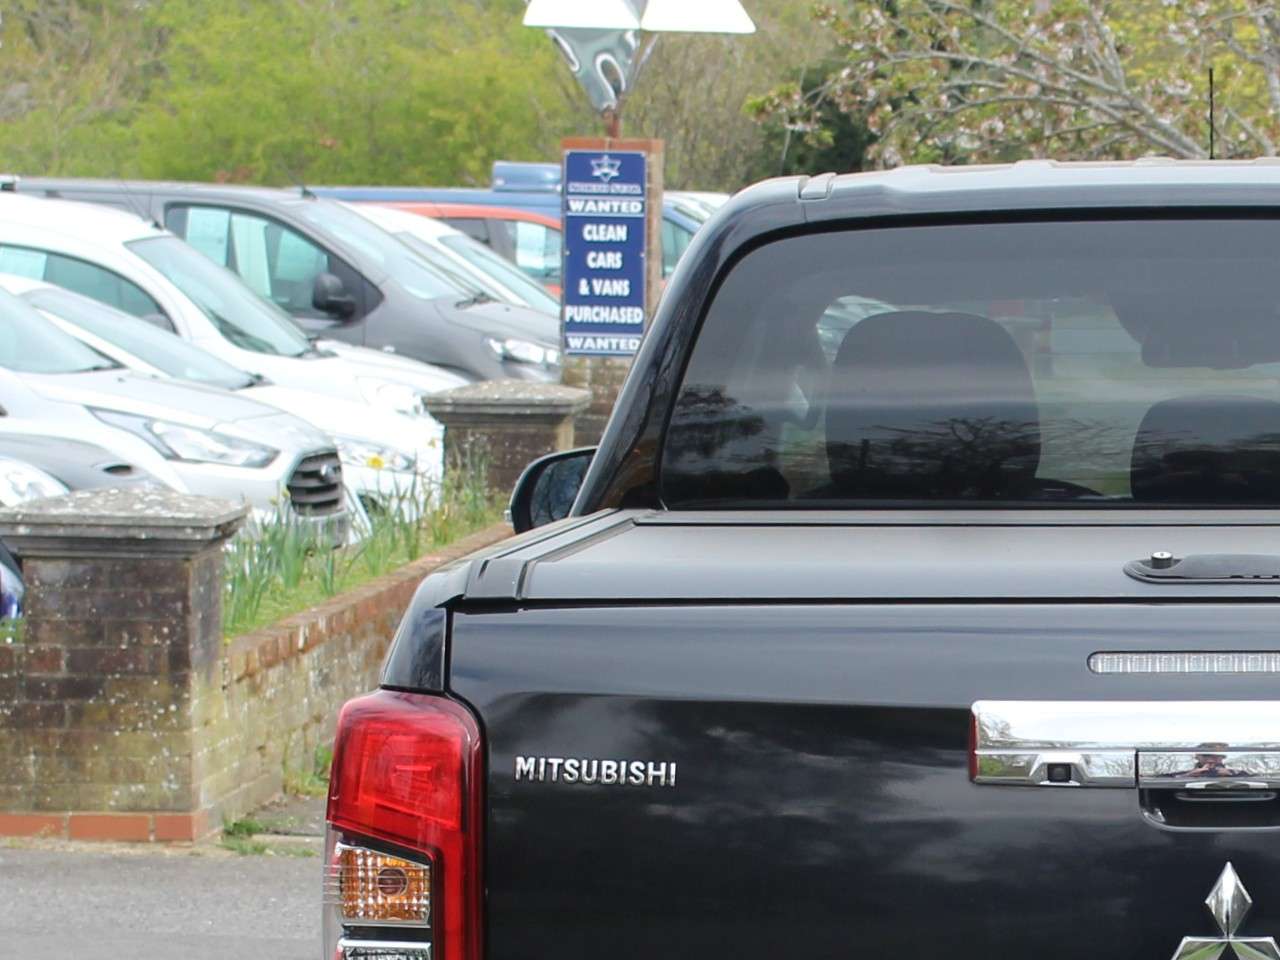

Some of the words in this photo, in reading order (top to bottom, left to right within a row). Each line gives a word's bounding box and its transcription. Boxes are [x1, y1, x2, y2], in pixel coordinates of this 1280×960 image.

[568, 200, 643, 214] WANTED
[583, 224, 628, 242] CLEAN
[586, 251, 623, 269] CARS
[579, 279, 590, 296] &
[592, 279, 630, 297] VANS
[565, 305, 644, 324] PURCHASED
[567, 337, 641, 350] WANTED
[515, 756, 677, 787] MITSUBISHI
